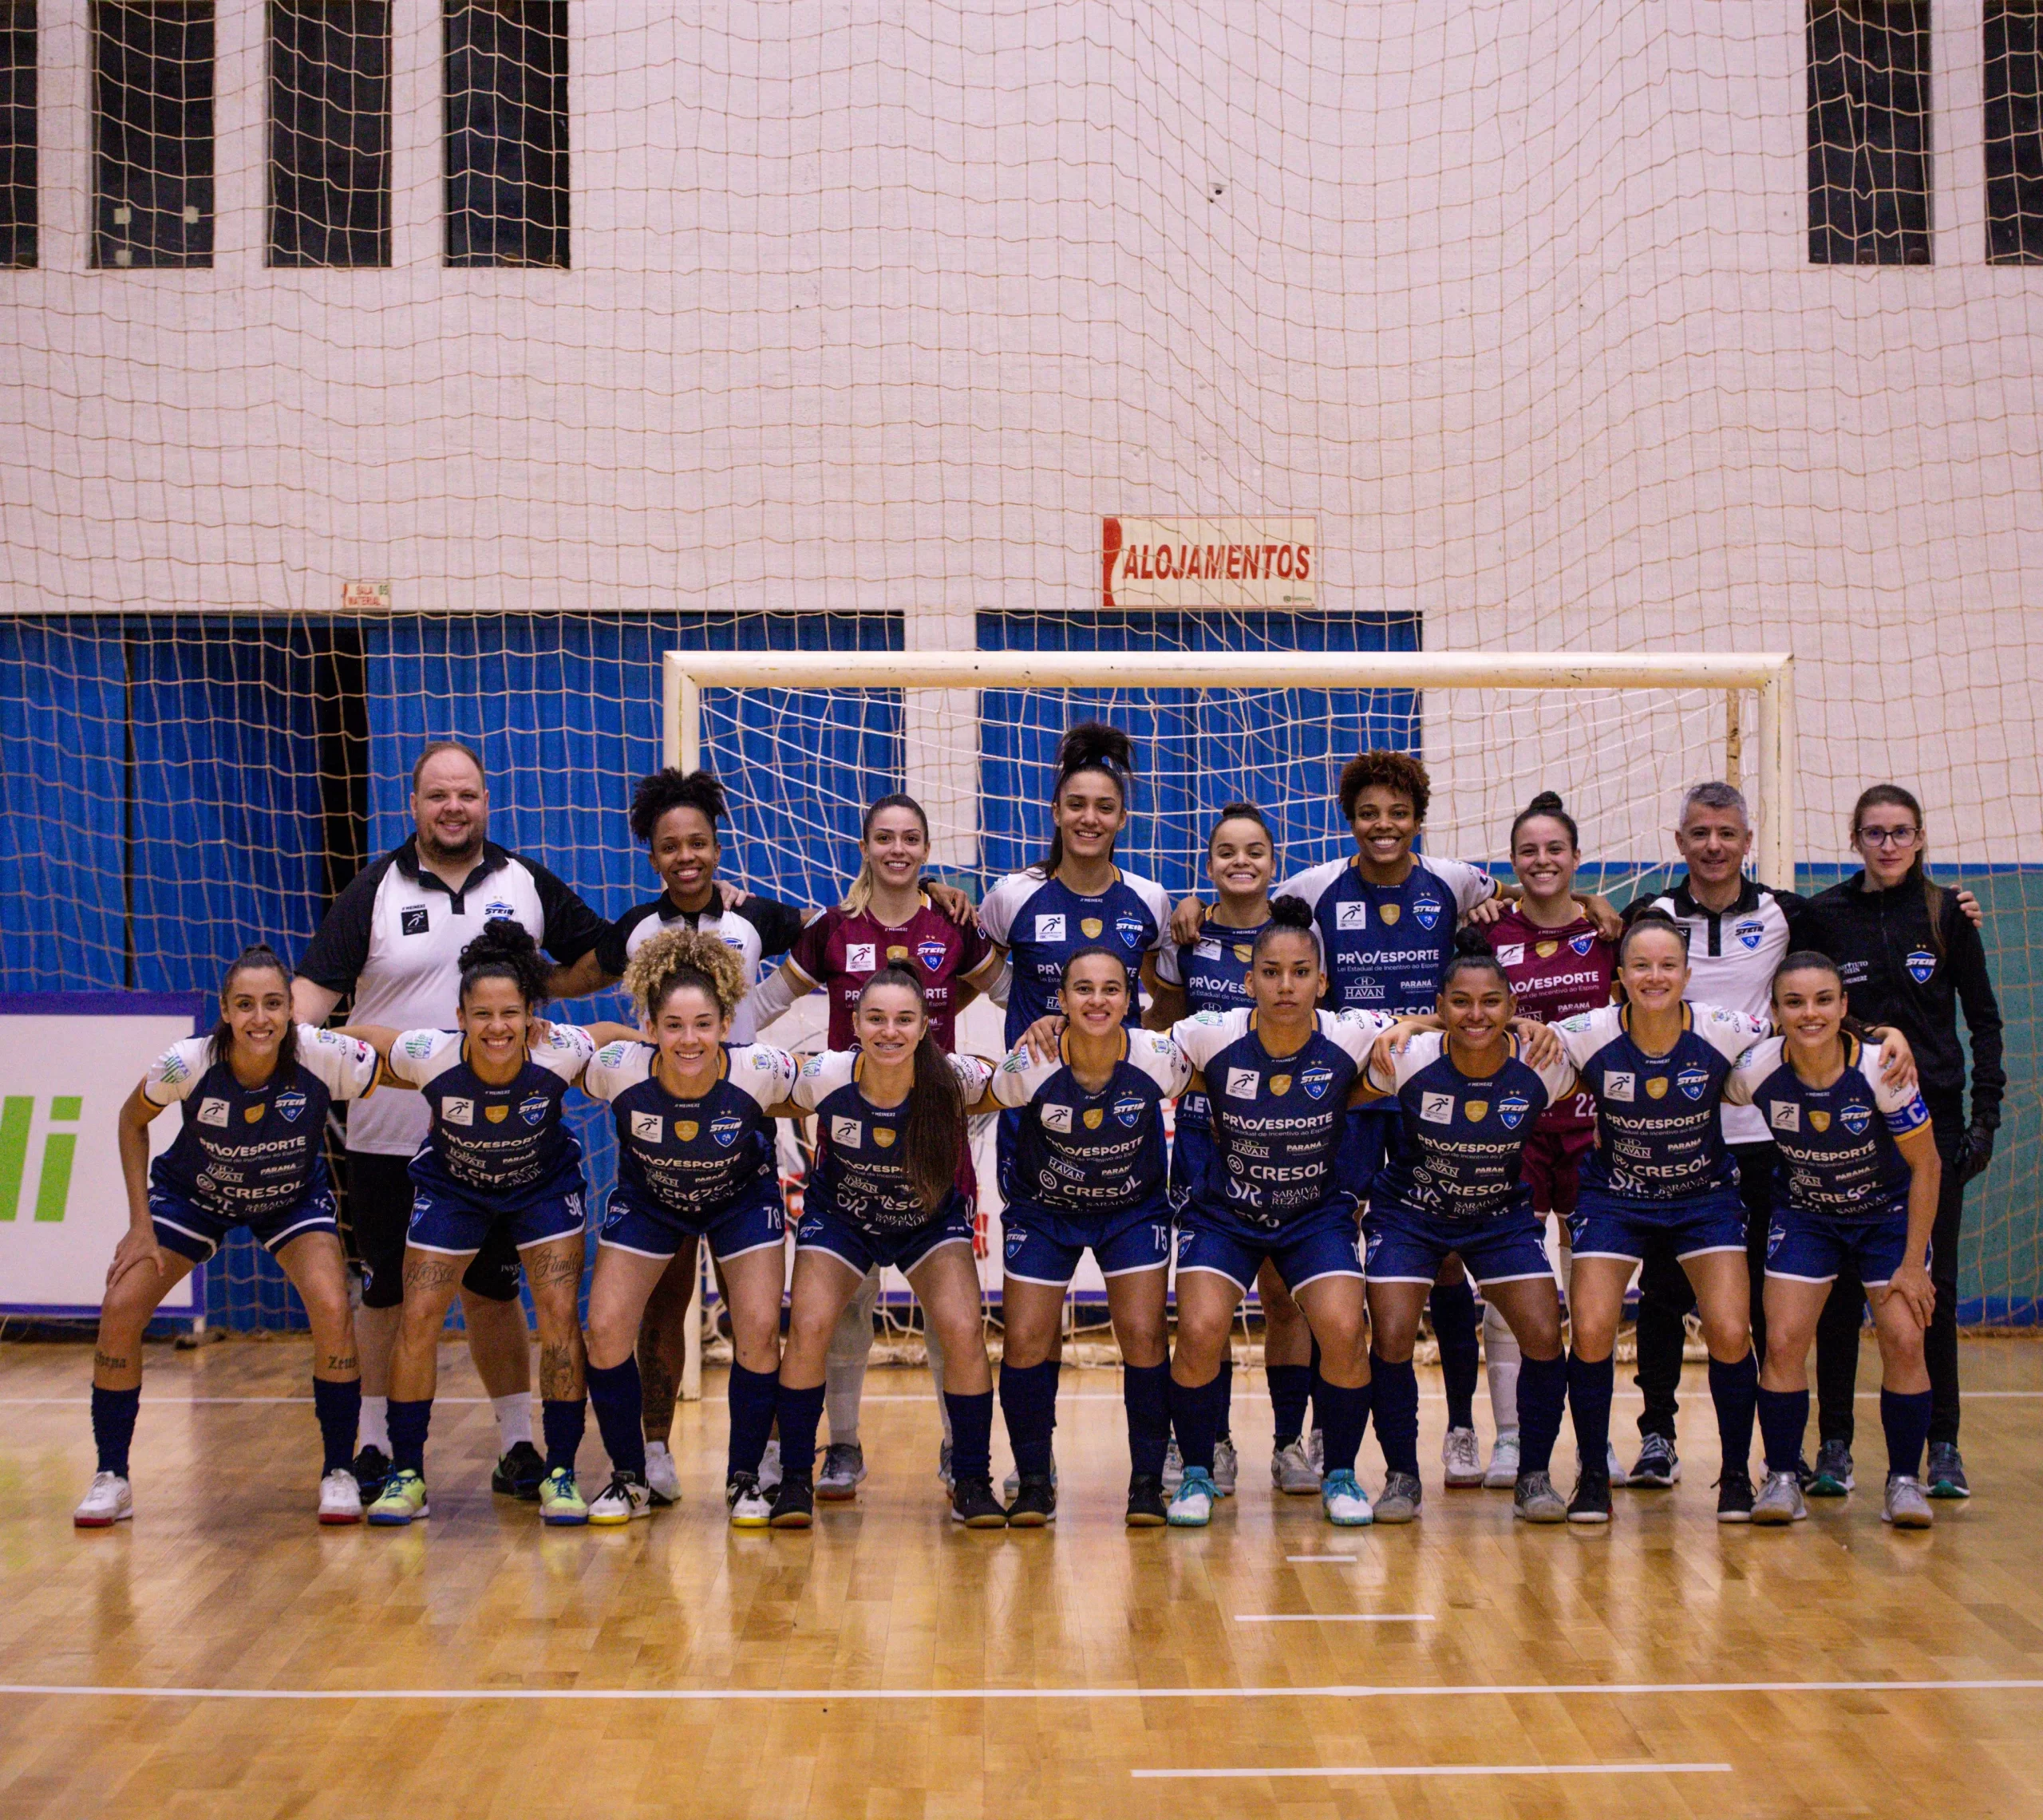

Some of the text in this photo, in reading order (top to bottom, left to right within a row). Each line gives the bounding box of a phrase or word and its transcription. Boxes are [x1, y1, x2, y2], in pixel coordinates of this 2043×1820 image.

[1122, 544, 1310, 579] ALOJAMENTOS
[1735, 925, 1764, 936] STEIN
[1401, 979, 1432, 988] PARANÁ
[1345, 988, 1384, 998] HAVAN
[1539, 988, 1568, 997] Incentivo
[1231, 995, 1257, 1004] Incentiv
[1558, 1001, 1591, 1012] PARANÁ
[1300, 1072, 1334, 1084] STEIN
[1677, 1074, 1709, 1086] STEIN
[275, 1097, 306, 1108] STEIN
[519, 1099, 551, 1115] STEIN
[1113, 1102, 1146, 1114] STEIN
[1497, 1103, 1530, 1112] STEIN
[1840, 1110, 1872, 1121] STEIN
[1907, 1102, 1926, 1124] C
[709, 1121, 742, 1133] STEIN
[1231, 1127, 1257, 1136] Estadual
[1310, 1124, 1334, 1135] Esporte
[1233, 1143, 1269, 1156] HAVAN
[1614, 1142, 1651, 1157] HAVAN
[1049, 1158, 1085, 1180] HAVAN
[1250, 1162, 1328, 1182] CRESOL
[1633, 1154, 1711, 1178] CRESOL
[223, 1180, 305, 1199] CRESOL
[1063, 1175, 1141, 1198] CRESOL
[1272, 1185, 1318, 1198] SARAIVA
[1438, 1180, 1512, 1196] CRESOL
[1808, 1180, 1883, 1203] CRESOL
[763, 1206, 781, 1230] 78
[1151, 1224, 1168, 1252] 75
